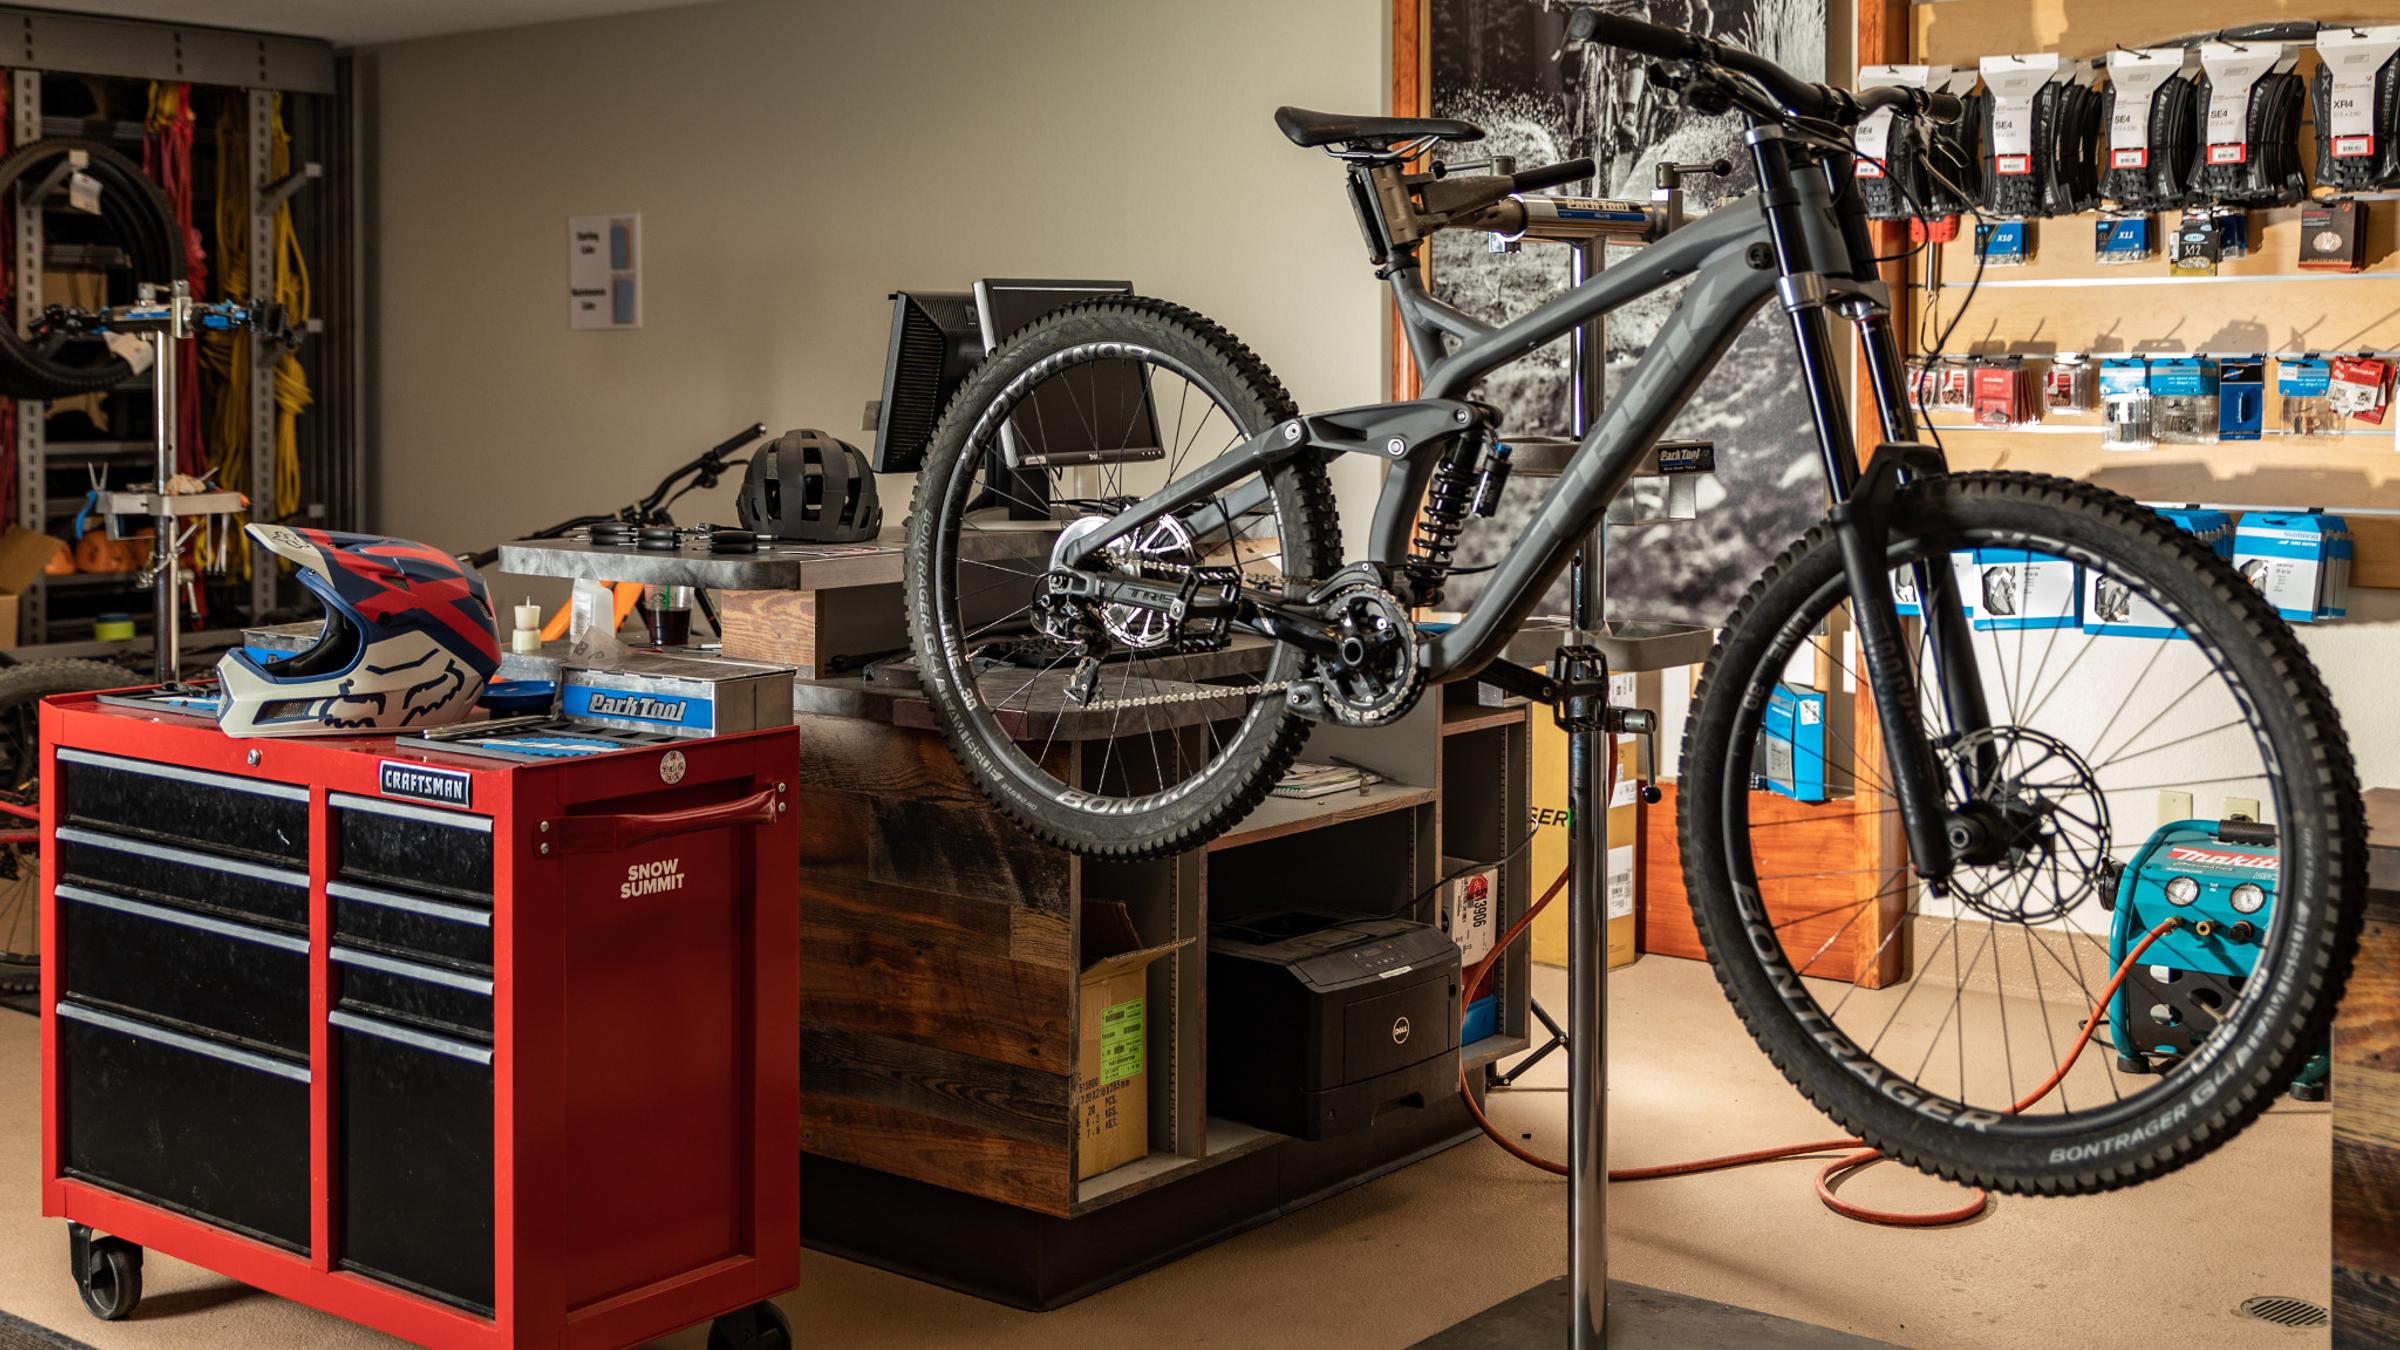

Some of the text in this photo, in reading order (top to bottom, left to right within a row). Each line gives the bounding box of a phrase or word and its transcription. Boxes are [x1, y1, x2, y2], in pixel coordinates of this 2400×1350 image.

[2210, 110, 2228, 119] SE4
[2333, 100, 2354, 110] XR4
[1857, 127, 1873, 136] SE4
[1995, 121, 2013, 130] SE4
[2113, 115, 2131, 125] SE4
[1997, 233, 2014, 243] X10
[960, 342, 1151, 474] BONTRAGER
[916, 508, 934, 628] BONTRAGER
[1128, 587, 1175, 602] TRE
[923, 631, 946, 674] G4
[940, 623, 964, 670] LINE
[960, 688, 979, 712] 30
[385, 769, 463, 799] CRAFTSMAN
[627, 857, 679, 881] SNOW
[621, 872, 685, 899] SUMMIT
[1733, 879, 2001, 1133] BONTRAGER
[2048, 1102, 2190, 1165] BONTRAGER
